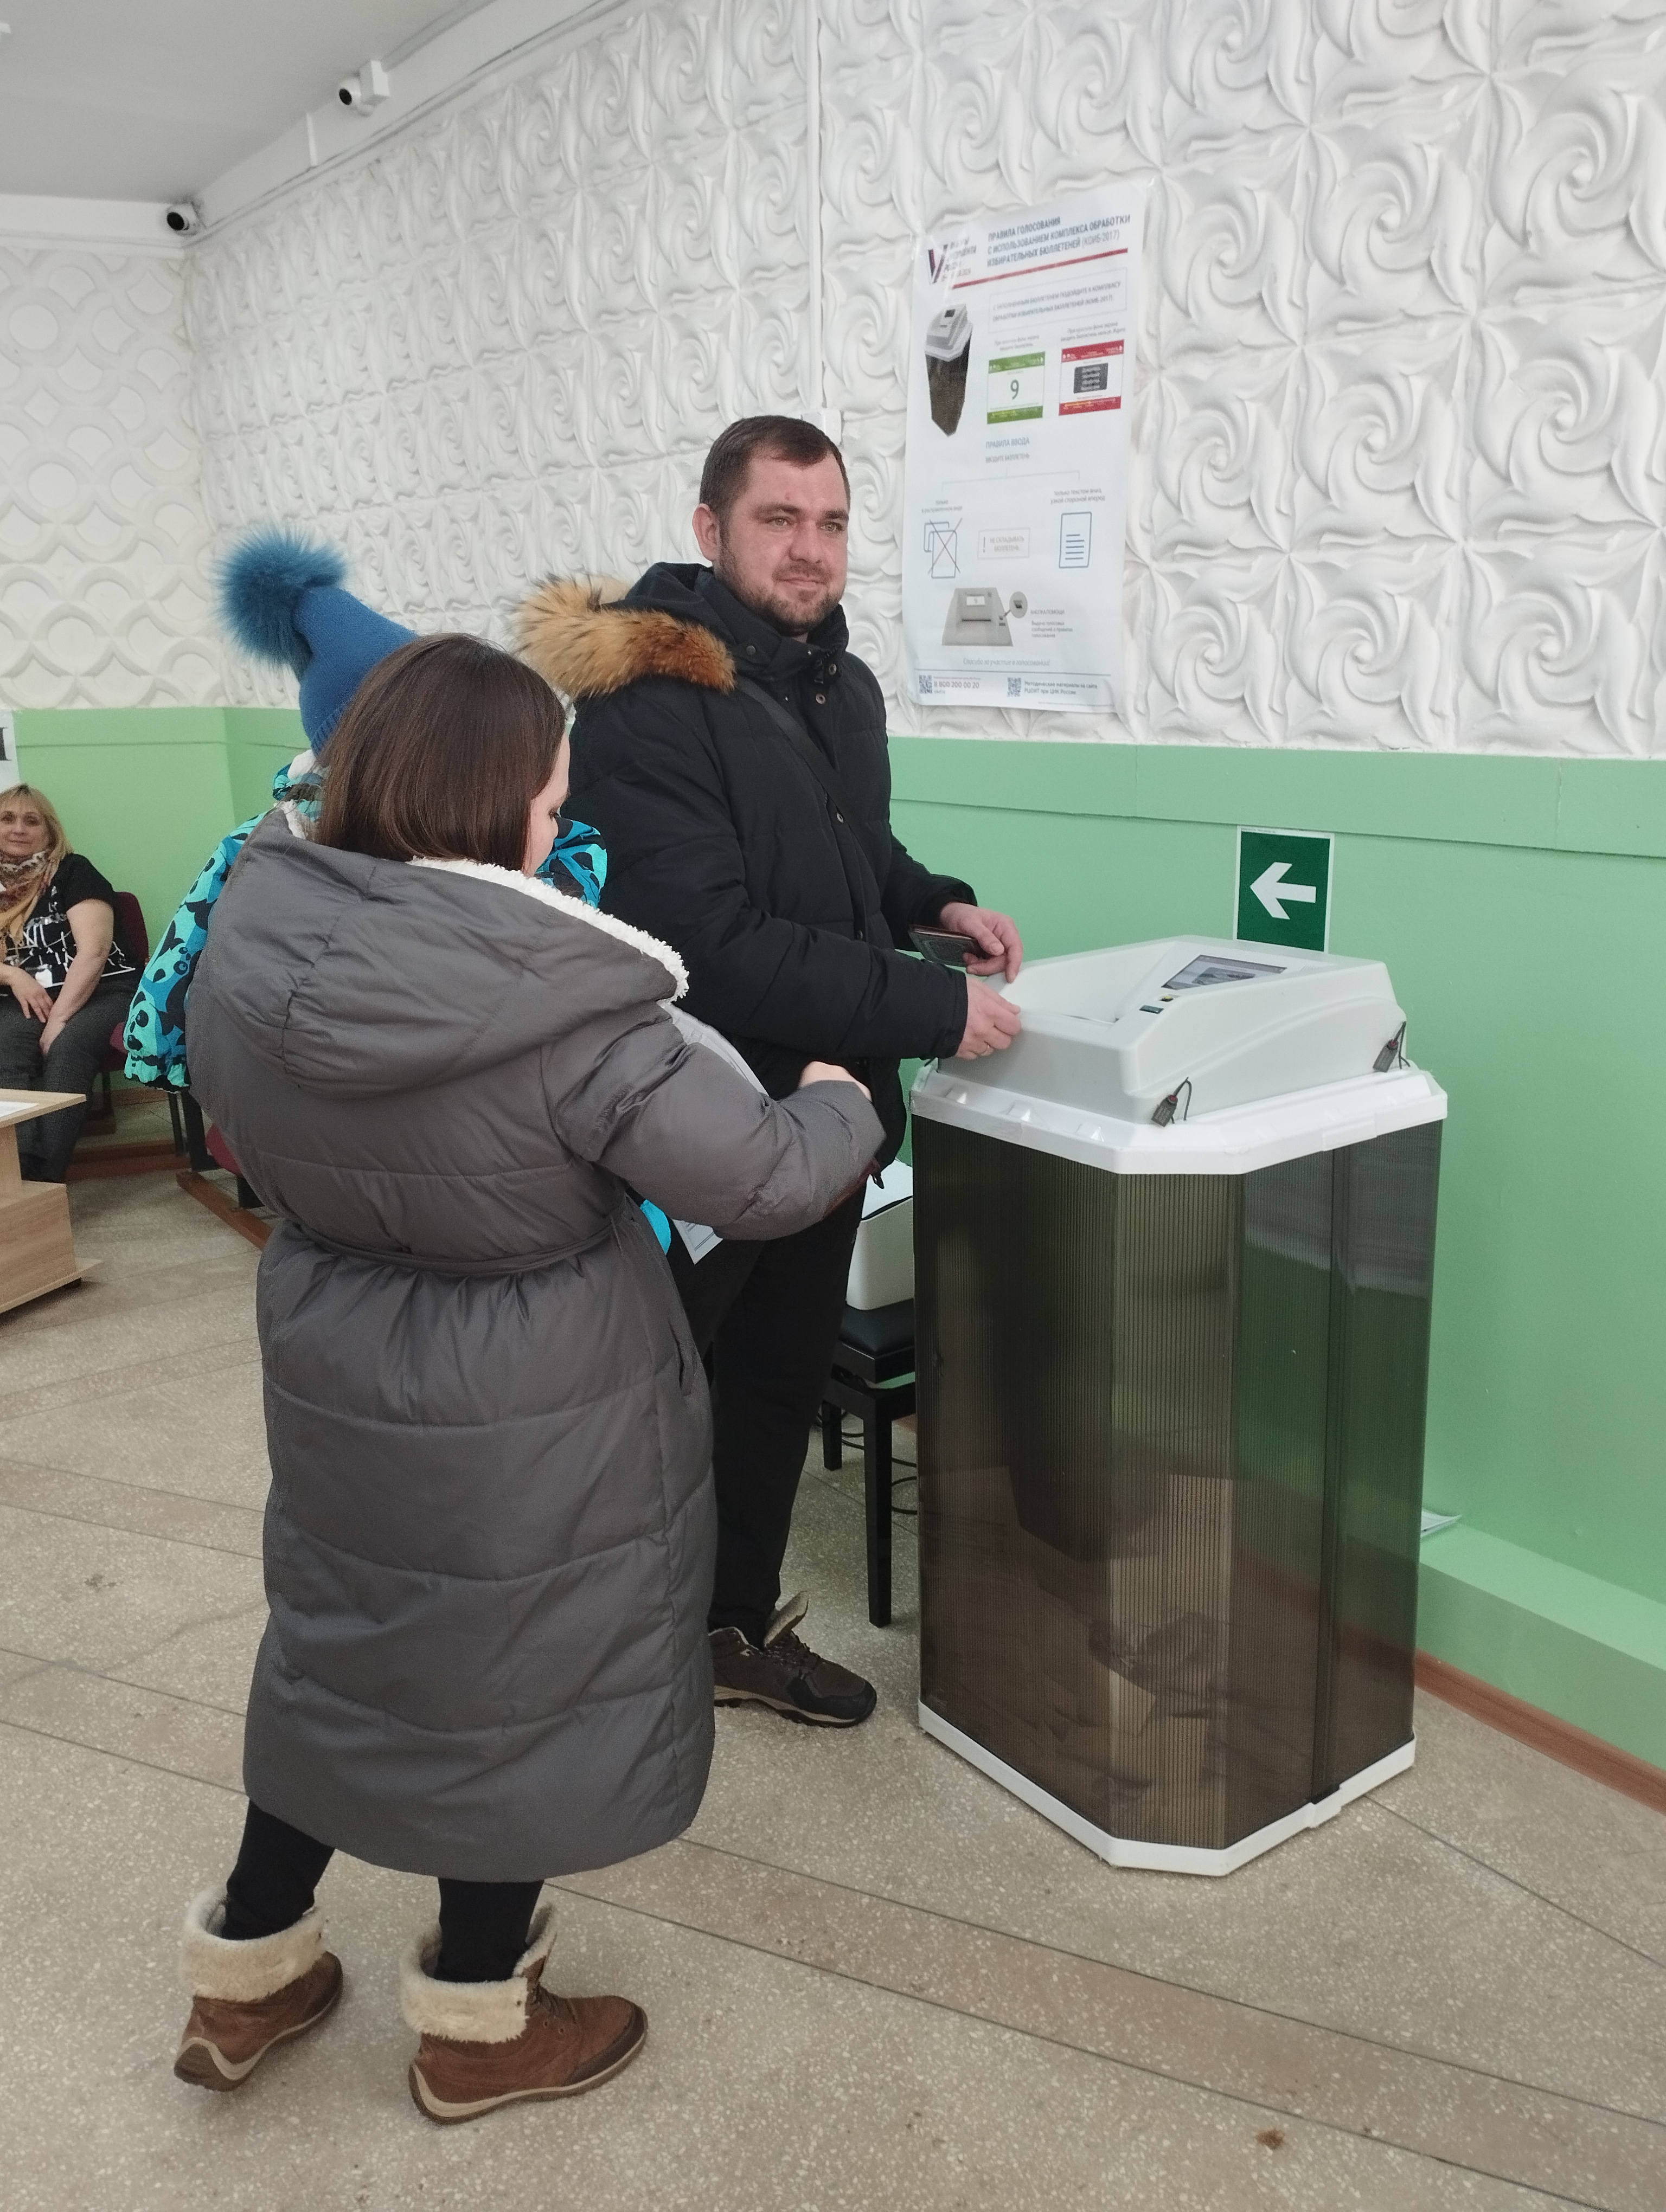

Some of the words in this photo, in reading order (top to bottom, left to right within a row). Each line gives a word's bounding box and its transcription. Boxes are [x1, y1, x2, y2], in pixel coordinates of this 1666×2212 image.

[988, 227, 1015, 242] ПРАВИЛА
[1017, 216, 1061, 235] ГОЛОСОВАНИЯ
[988, 246, 992, 255] С
[993, 233, 1049, 253] ИСПОЛЬЗОВАНИЕМ
[1050, 223, 1088, 240] КОМПЛЕКСА
[1090, 214, 1130, 231] ОБРАБОТКИ
[987, 248, 1038, 267] ИЗБИРАТЕЛЬНЫХ
[1040, 237, 1080, 255] БЮЛЛЕТЕНЕЙ
[1010, 380, 1018, 400] 9
[985, 439, 1010, 449] ПРАВИЛА
[1011, 437, 1030, 446] ВВОДА
